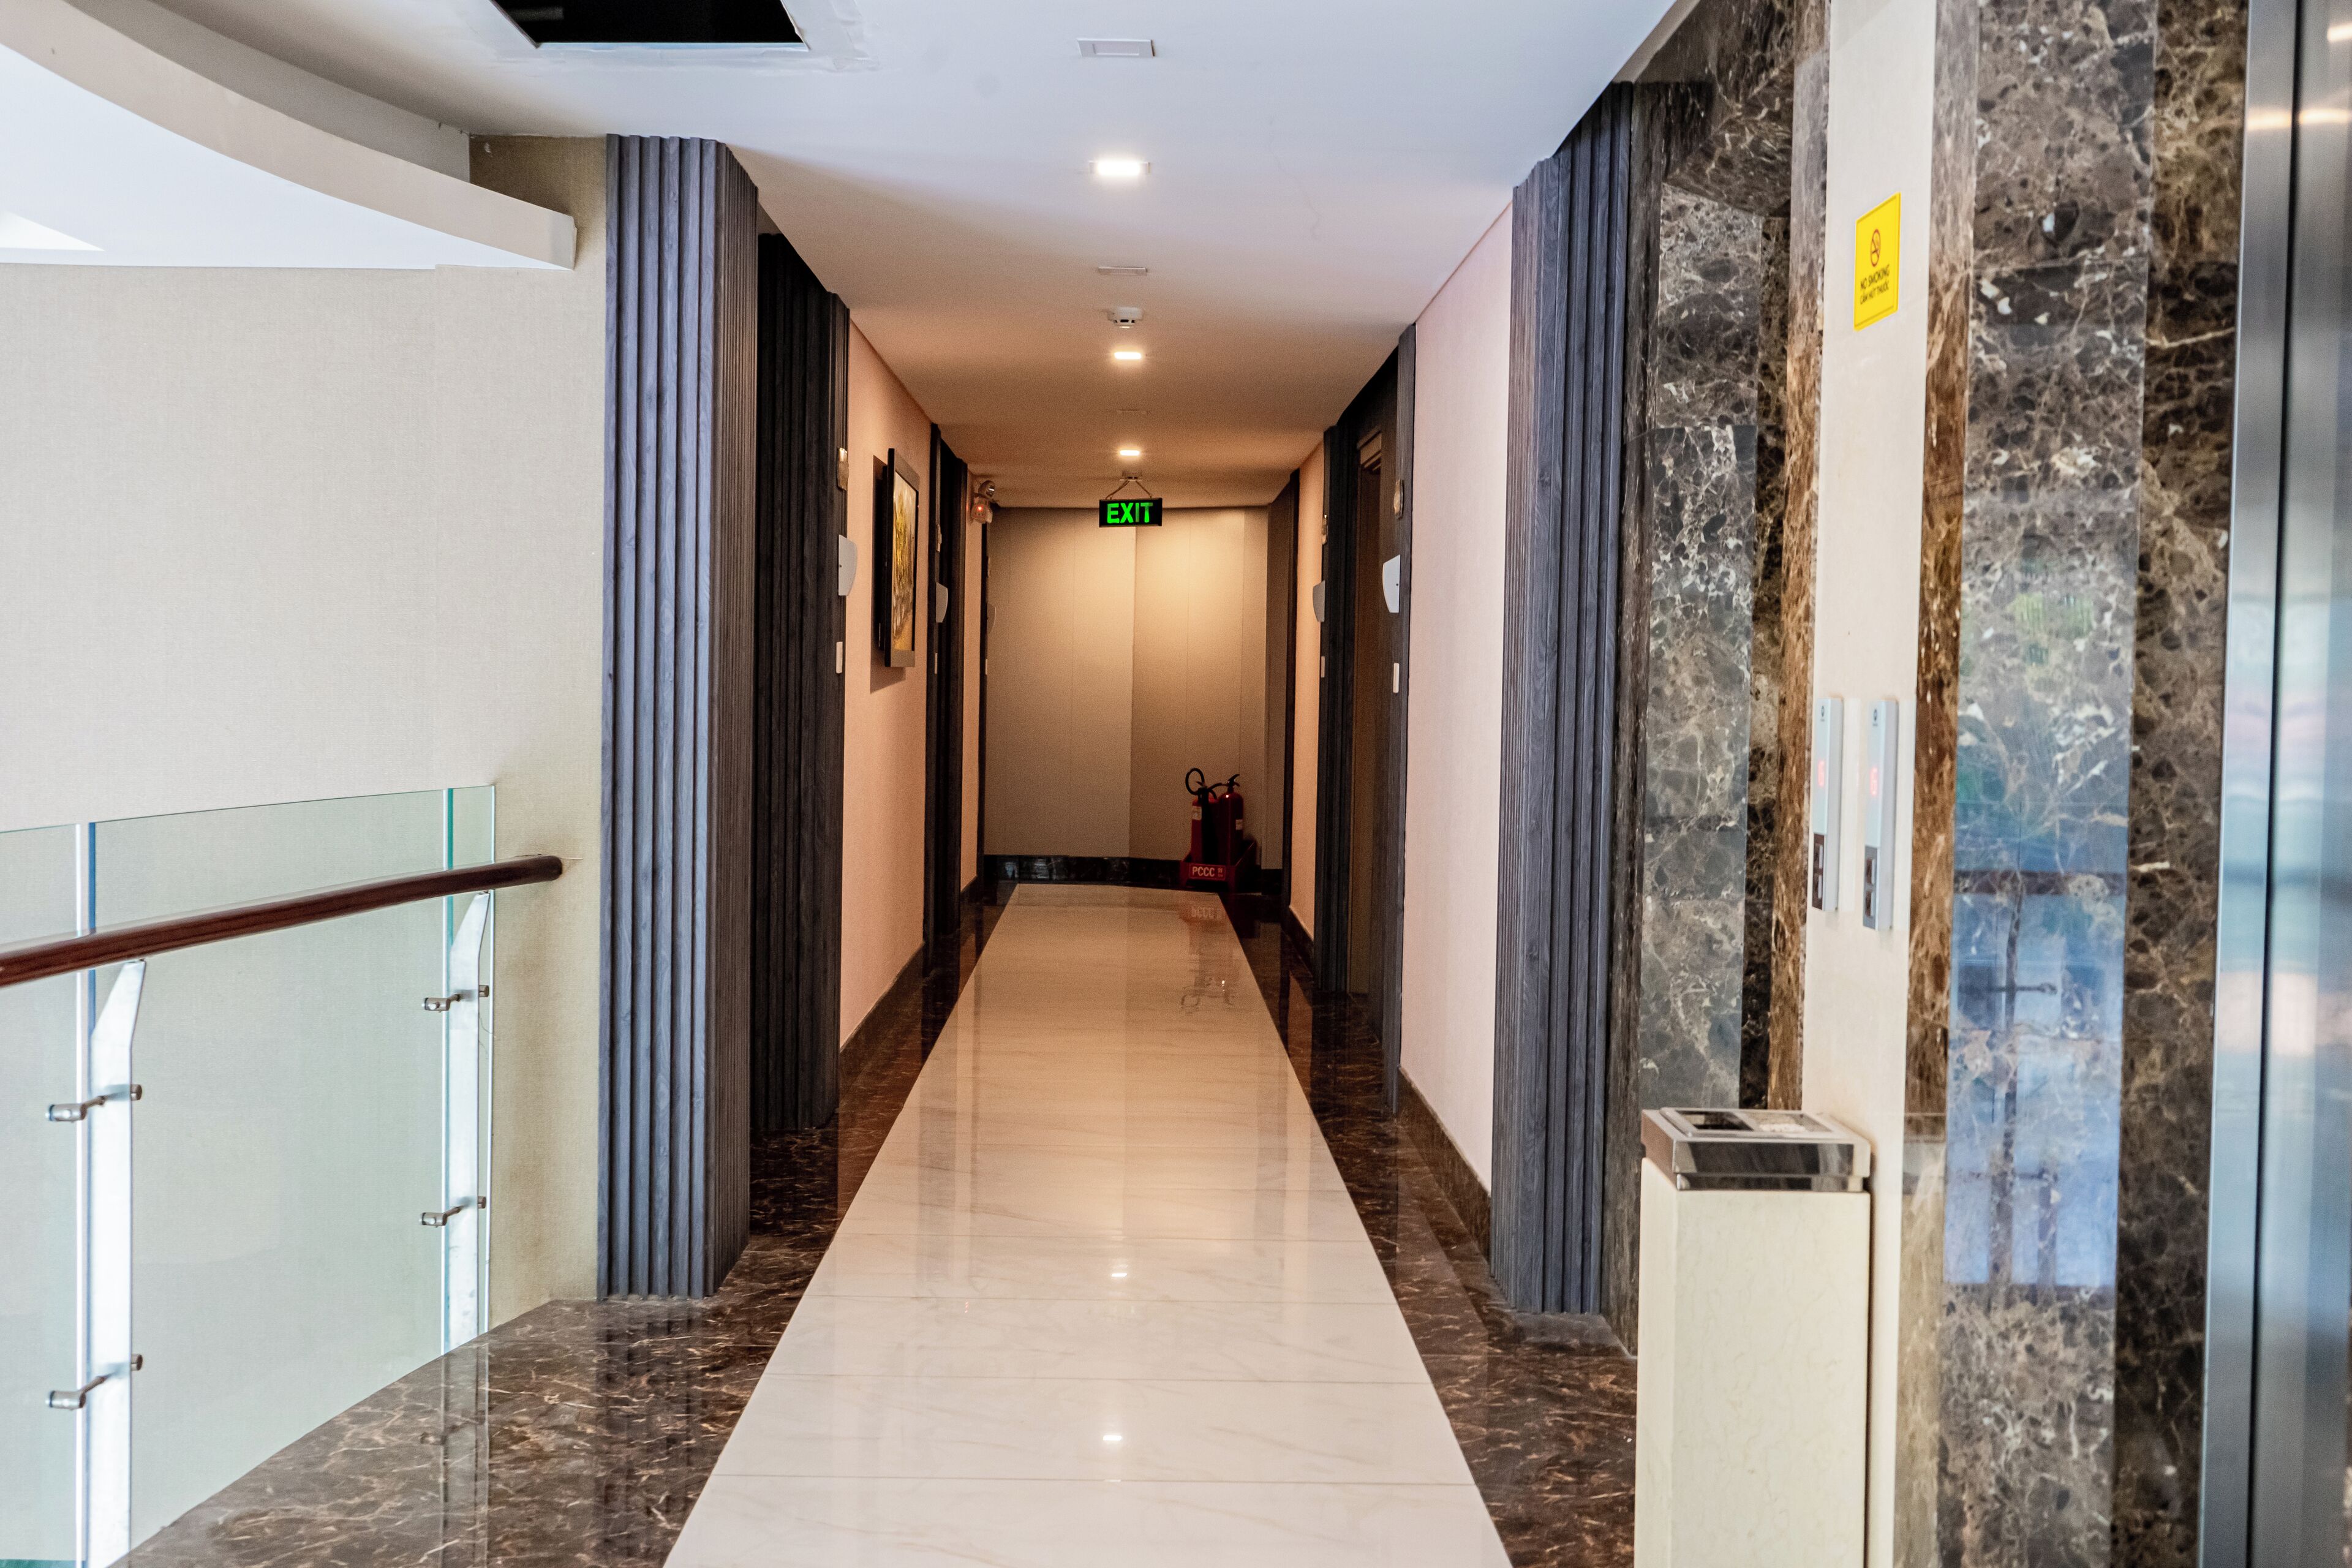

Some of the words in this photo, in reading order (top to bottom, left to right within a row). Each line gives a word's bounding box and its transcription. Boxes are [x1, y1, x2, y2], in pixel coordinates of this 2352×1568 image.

[1868, 264, 1890, 287] SMOKING
[1107, 502, 1153, 524] EXIT
[1192, 866, 1215, 877] PCCC
